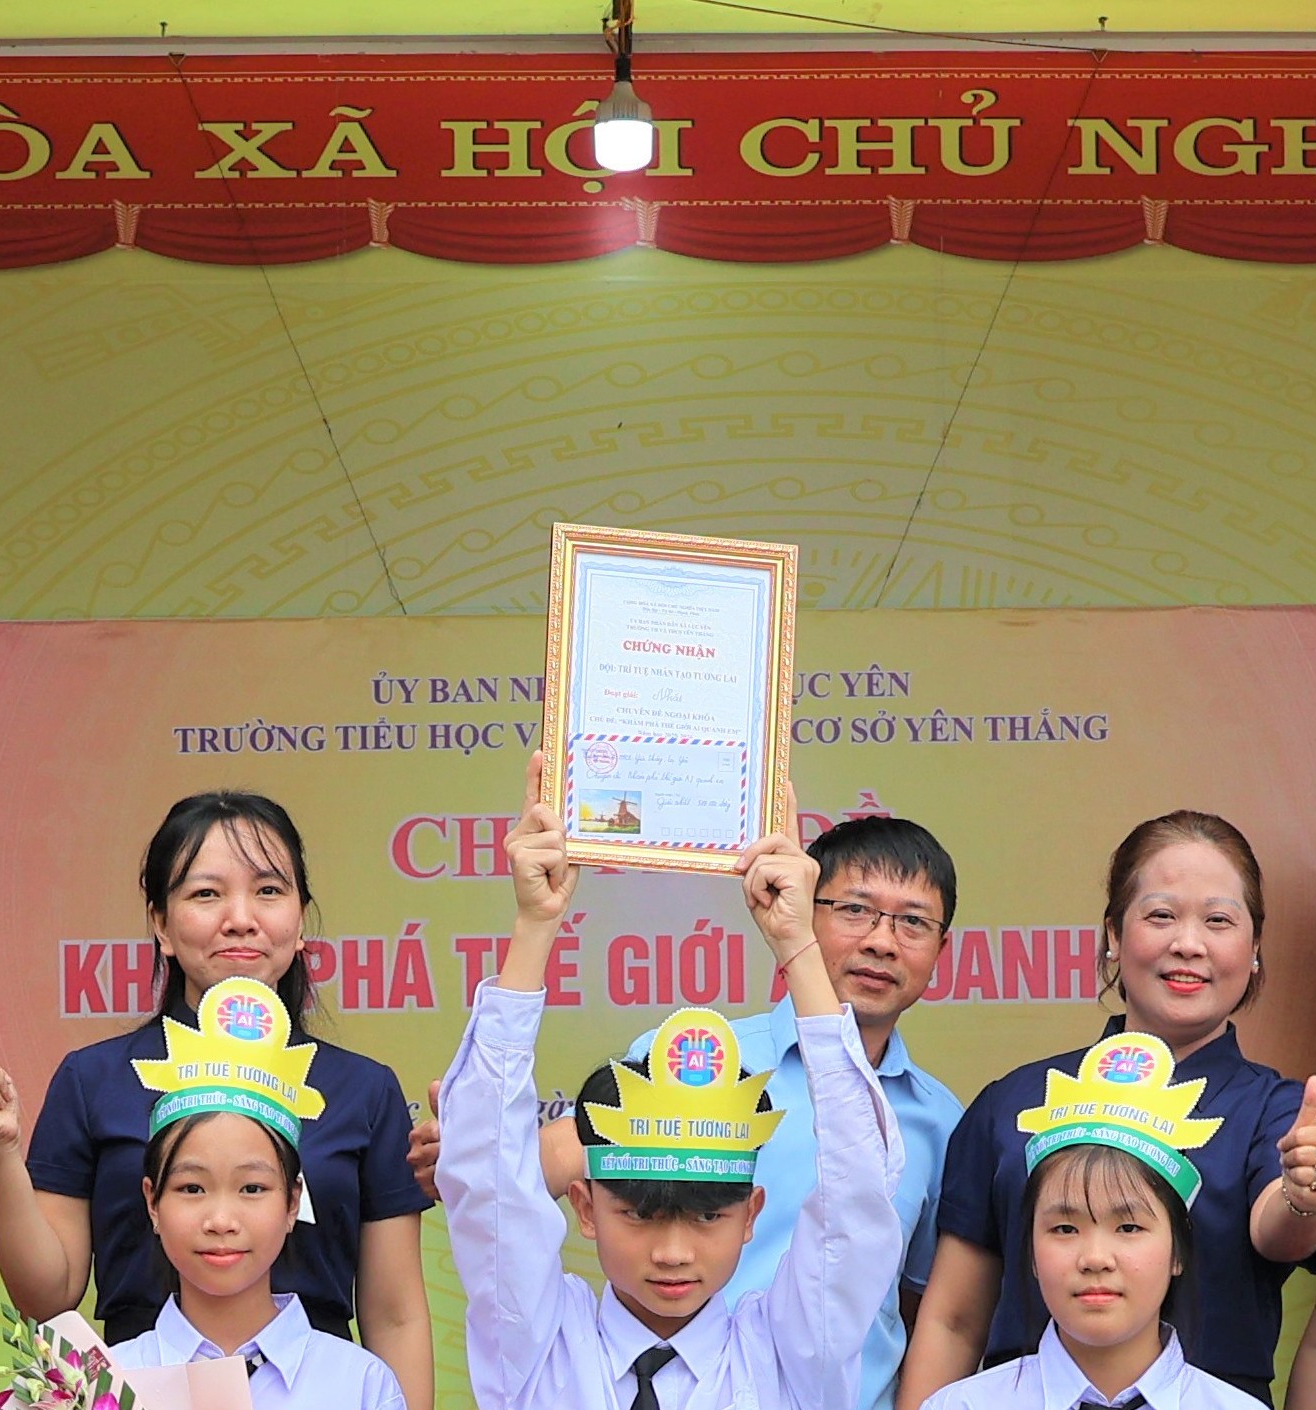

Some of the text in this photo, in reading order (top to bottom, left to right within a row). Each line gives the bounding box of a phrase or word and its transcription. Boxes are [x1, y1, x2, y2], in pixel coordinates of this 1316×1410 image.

[197, 104, 398, 180] XÃ
[740, 89, 1022, 177] CHỦ
[623, 639, 716, 660] CHỨNG NHẬN
[372, 671, 420, 704] ỦY
[428, 677, 499, 703] BAN
[840, 664, 911, 697] YÊN
[174, 720, 327, 754] TRƯỜNG
[334, 716, 417, 750] TIỂU
[428, 723, 504, 755] HỌC
[792, 717, 842, 744] CƠ
[851, 710, 896, 743] SỞ
[904, 708, 974, 742] YÊN
[985, 710, 1109, 743] THẮNG
[608, 919, 743, 1006] GIỚI
[237, 1016, 253, 1027] AI
[688, 1055, 703, 1067] AI
[1117, 1062, 1132, 1071] AI
[281, 1082, 297, 1104] LAI
[735, 1122, 749, 1139] LAI
[1152, 1116, 1175, 1135] LAI
[633, 1157, 649, 1170] TRI
[651, 1155, 678, 1171] THỨC
[686, 1156, 712, 1173] SÁNG
